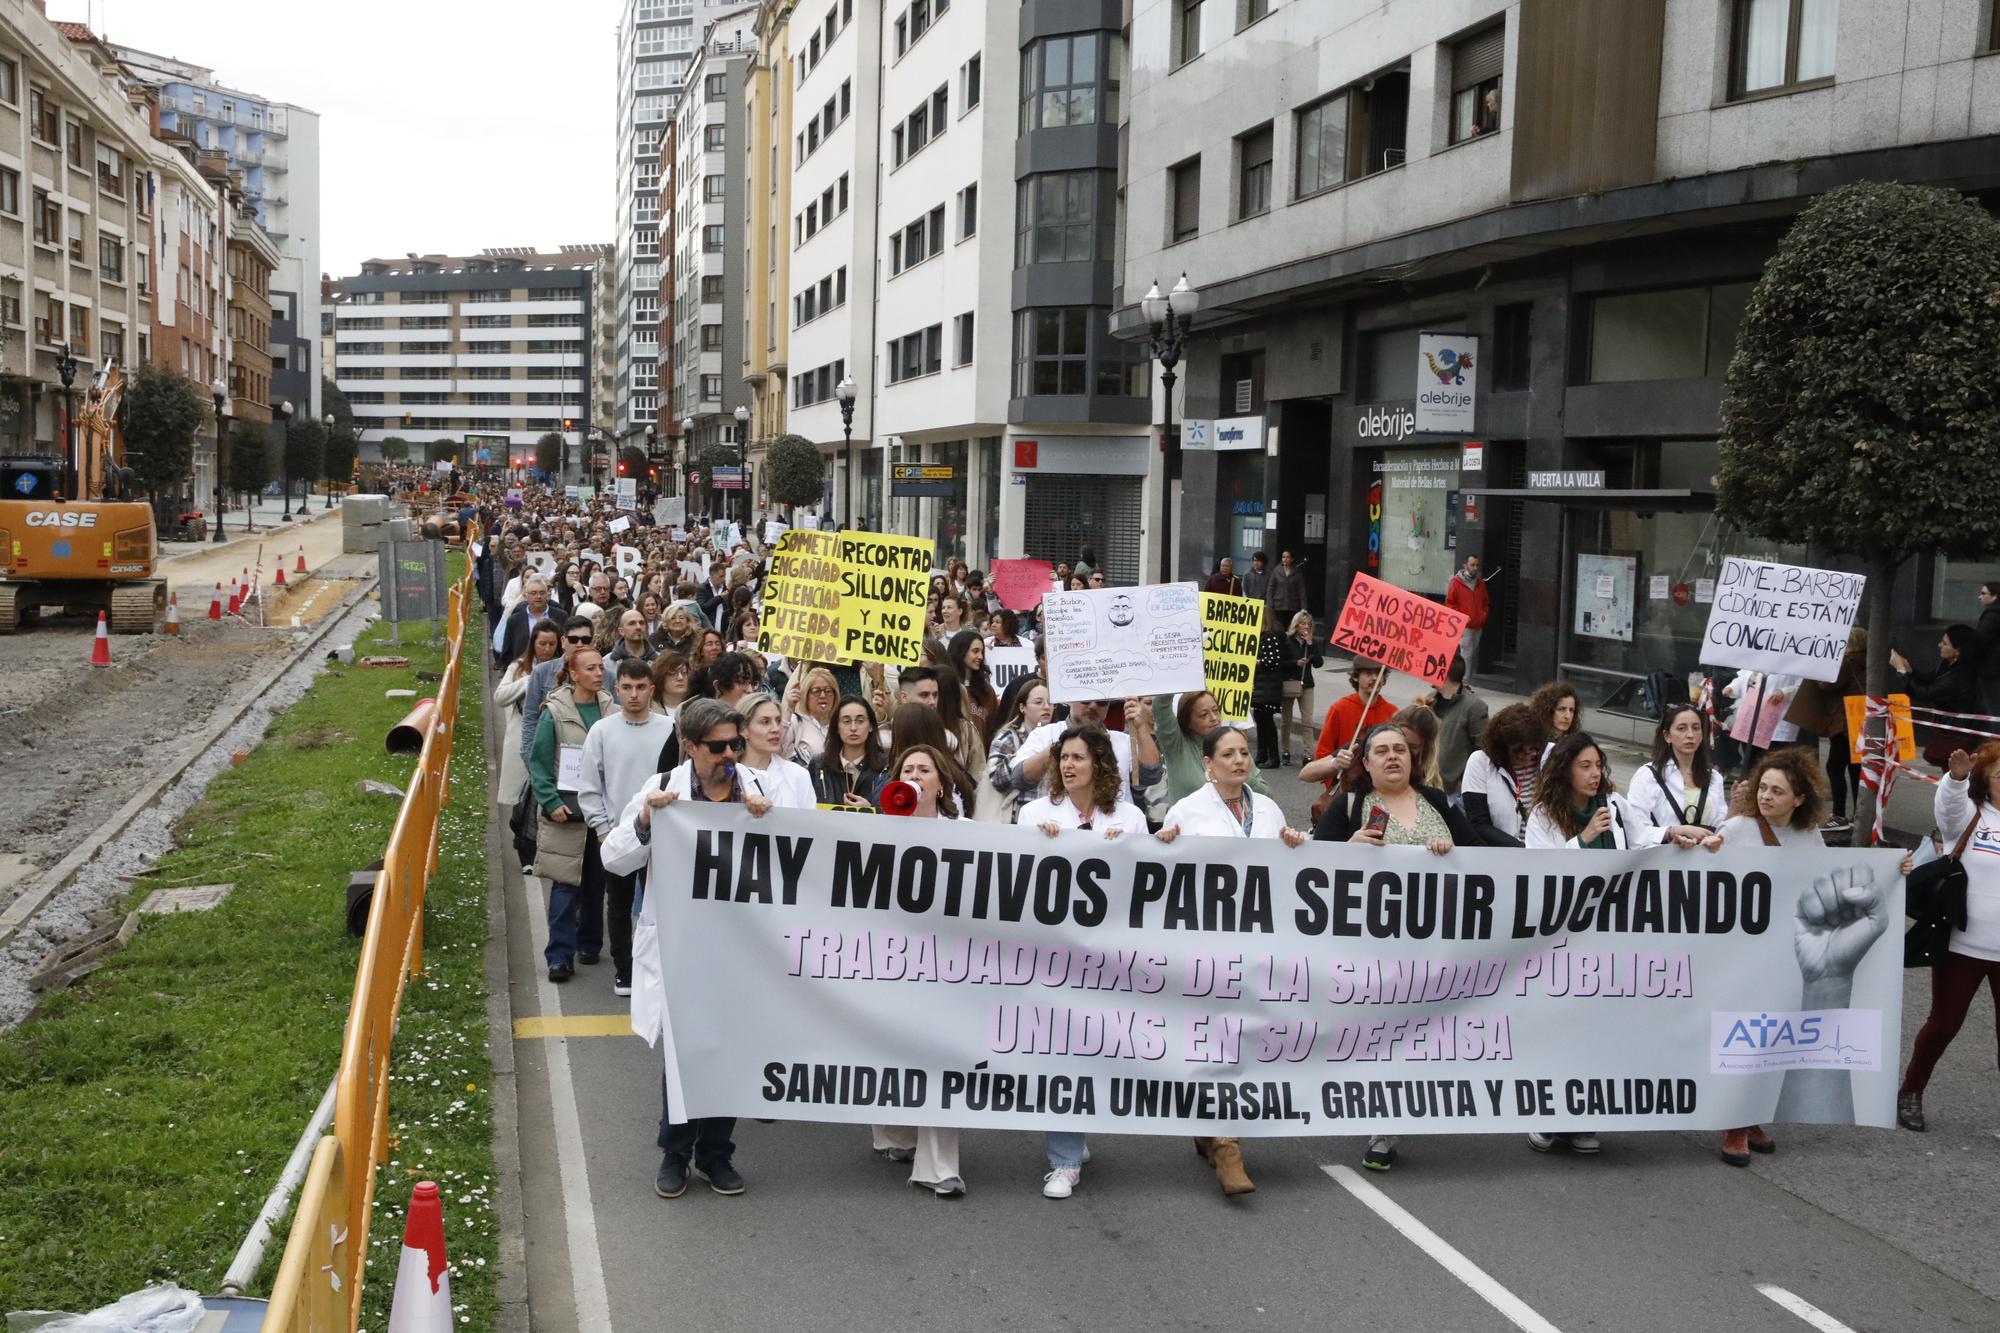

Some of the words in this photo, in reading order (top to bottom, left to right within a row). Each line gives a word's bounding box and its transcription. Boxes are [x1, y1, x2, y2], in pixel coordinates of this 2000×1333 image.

[1420, 391, 1472, 407] alebrije
[1358, 406, 1415, 442] alebrije
[1433, 476, 1447, 488] Artes
[1531, 472, 1562, 487] PUERTA
[1564, 473, 1575, 487] LA
[1576, 472, 1601, 487] VILLA
[26, 511, 98, 528] CASE
[776, 532, 842, 558] SOMETI
[842, 540, 932, 573] RECORTAD
[841, 568, 926, 607] SILLONES
[1723, 561, 1777, 593] DIME,
[860, 608, 870, 626] Y
[881, 613, 911, 631] NO
[1206, 599, 1260, 627] BARBÓN
[1376, 595, 1400, 615] NO
[1402, 600, 1462, 638] SABES
[1718, 587, 1781, 619] ¿DÓNDE
[1787, 599, 1831, 623] ESTÁ
[845, 628, 921, 662] PEONES
[1203, 627, 1258, 656] SCUCHA
[1344, 607, 1429, 653] MANDAR,
[758, 631, 848, 663] AGOTADO
[1388, 646, 1414, 673] HAS
[692, 830, 813, 905] HAY
[831, 840, 1111, 928] MOTIVOS
[1129, 861, 1274, 933] PARA
[1295, 867, 1495, 940] SEGUIR
[1511, 869, 1771, 939] LUCHANDO
[783, 927, 1167, 994] TRABAJADORXS
[1182, 950, 1244, 999] DE
[1259, 955, 1310, 1002] LA
[1328, 956, 1506, 1006] SANIDAD
[1514, 937, 1694, 999] PÚBLICA
[990, 1003, 1167, 1060] UNIDXS
[1185, 1014, 1243, 1065] EN
[1257, 1018, 1318, 1064] SU
[1326, 1014, 1512, 1062] DEFENSA
[1722, 1013, 1822, 1048] ATAS
[762, 1062, 928, 1109] SANIDAD
[941, 1060, 1096, 1116] PÚBLICA
[1109, 1077, 1311, 1124] UNIVERSAL,
[1322, 1079, 1476, 1120] GRATUITA
[1484, 1079, 1505, 1117] Y
[1515, 1079, 1556, 1117] DE
[1565, 1077, 1697, 1116] CALIDAD
